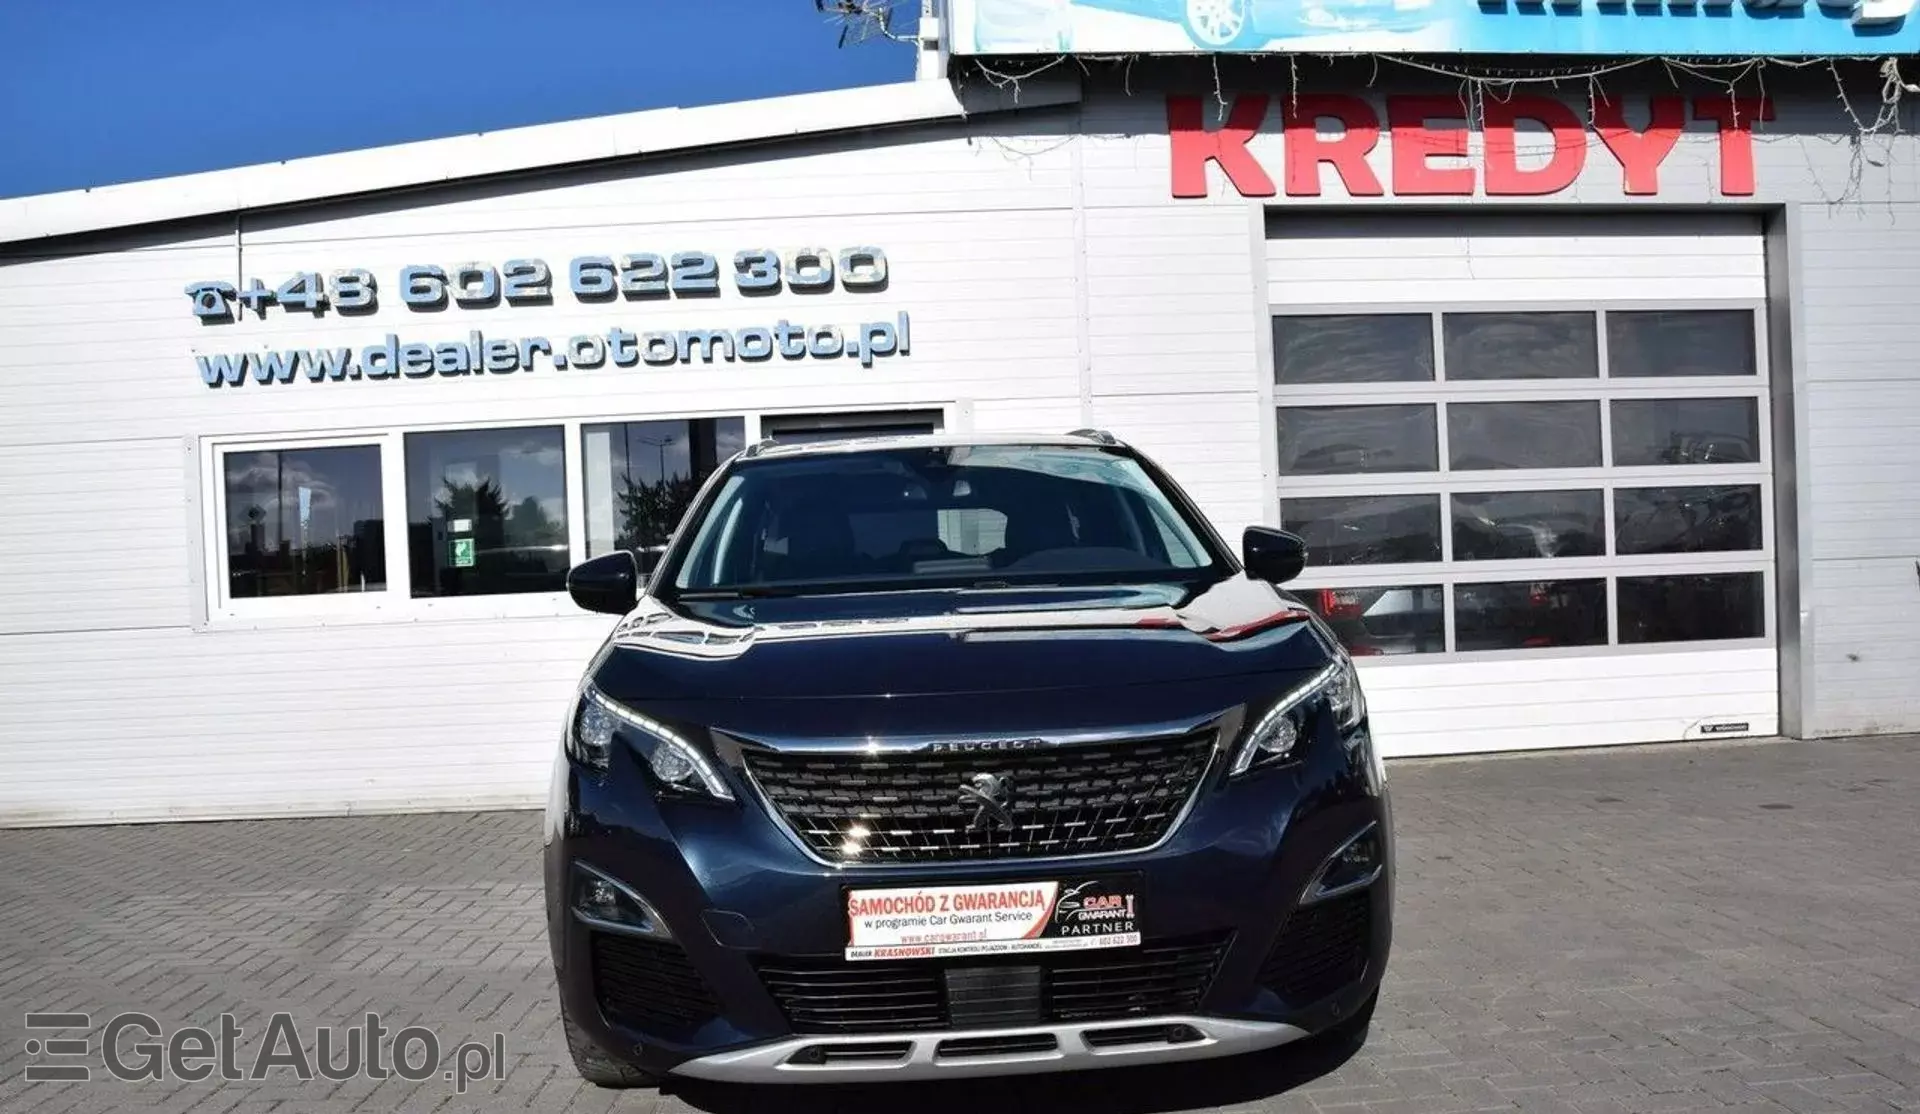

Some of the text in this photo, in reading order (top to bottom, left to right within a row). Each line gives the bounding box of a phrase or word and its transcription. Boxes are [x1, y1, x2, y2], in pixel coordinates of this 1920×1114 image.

[1168, 94, 1775, 197] KREDYT
[237, 246, 889, 319] +48 602 622 300
[196, 310, 911, 389] www.dealer.otomoto.pl
[932, 738, 1041, 752] PEUGEOT
[849, 889, 1045, 917] SAMOCHÓD Z GWARANCJĄ
[1083, 895, 1122, 909] CAR
[864, 910, 1033, 930] w programie Car Gwarant Service
[1078, 909, 1127, 920] GWARANT
[1061, 921, 1134, 936] PARTNER
[874, 946, 936, 958] KRASNOWSKI
